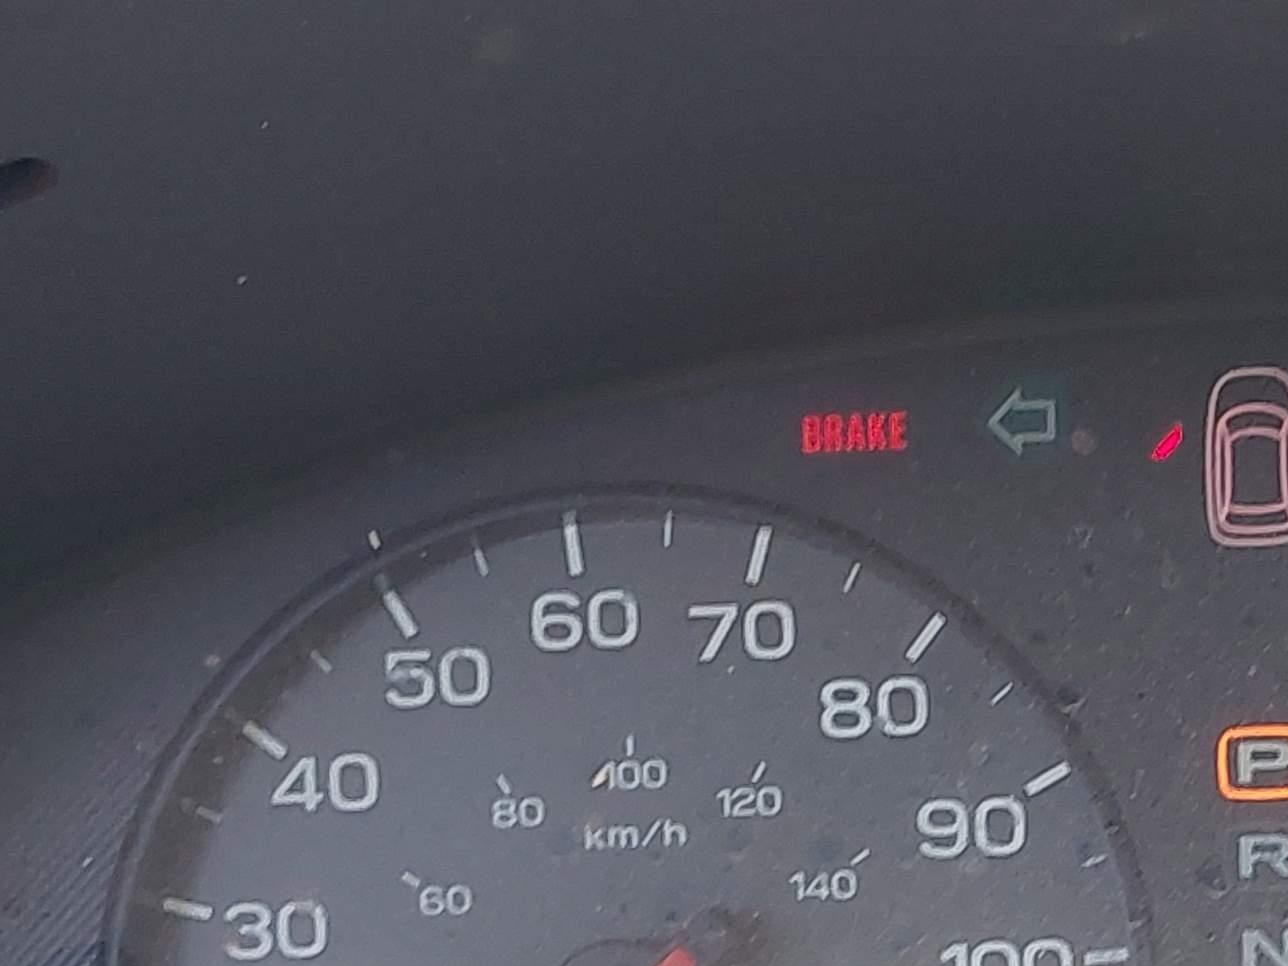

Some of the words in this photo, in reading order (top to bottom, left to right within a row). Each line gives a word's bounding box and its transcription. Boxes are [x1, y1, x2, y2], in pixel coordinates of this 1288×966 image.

[802, 410, 907, 453] BRAKE
[529, 589, 640, 652] 60
[689, 601, 796, 663] 70
[384, 646, 491, 707] 50
[819, 676, 929, 739] 80
[270, 752, 380, 813] 40
[602, 759, 668, 790] 100
[491, 798, 546, 828] 80
[717, 785, 782, 819] 120
[583, 819, 688, 851] km/h
[916, 797, 1026, 859] 90
[419, 886, 472, 916] 60
[789, 869, 857, 901] 140
[223, 901, 329, 960] 30
